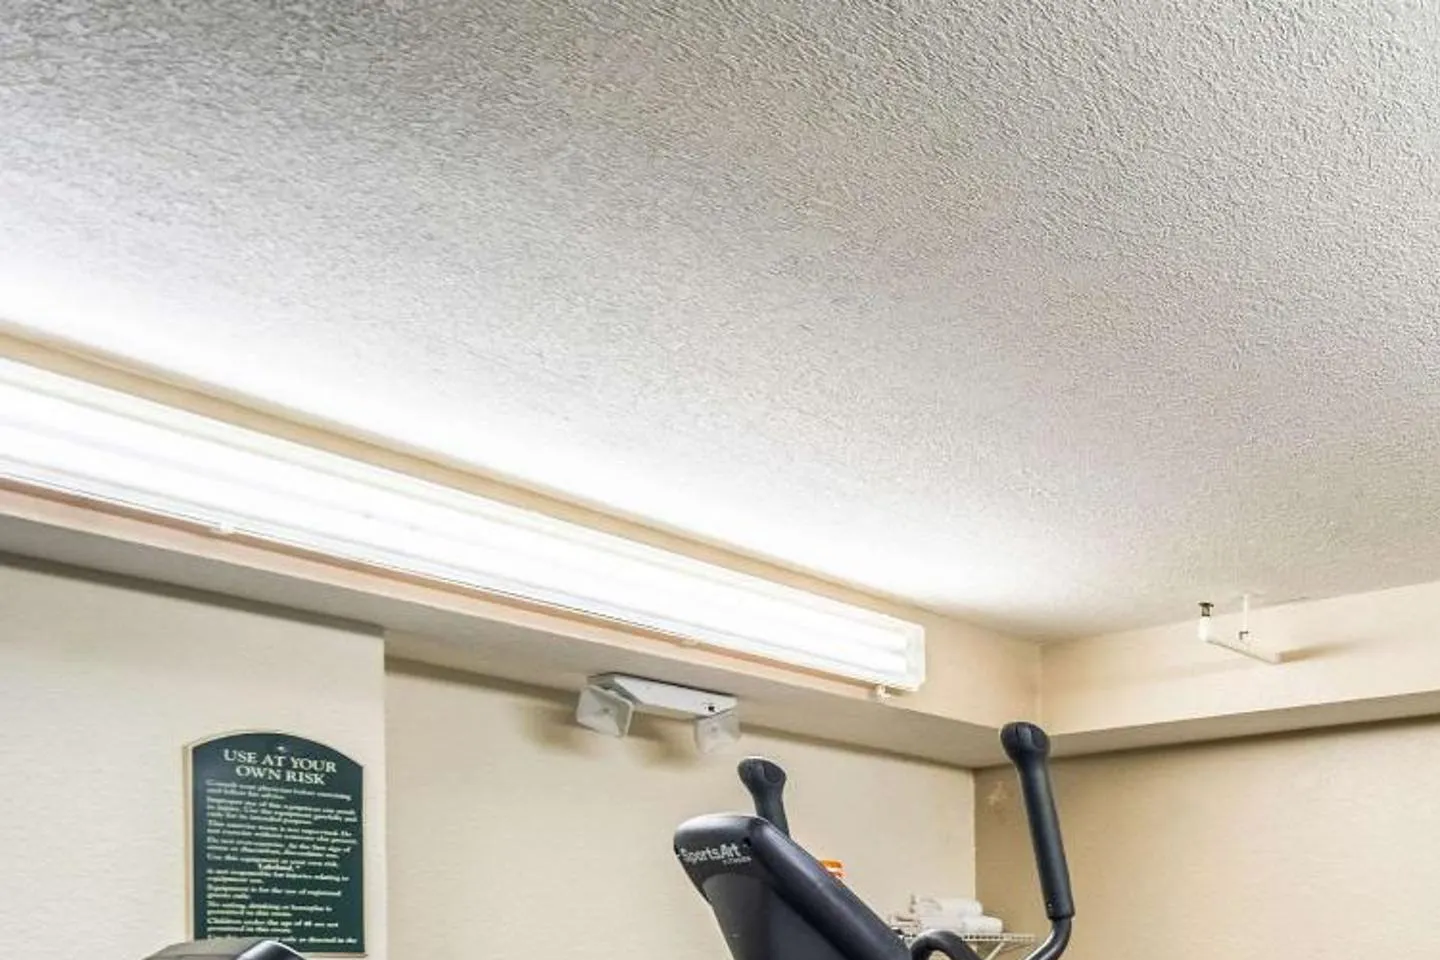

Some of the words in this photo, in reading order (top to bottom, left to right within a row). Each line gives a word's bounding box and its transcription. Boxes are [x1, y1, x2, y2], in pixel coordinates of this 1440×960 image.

[223, 748, 257, 765] USE
[261, 753, 287, 767] AT
[290, 756, 337, 773] YOUR
[235, 764, 282, 780] OWN
[285, 769, 326, 785] RISK
